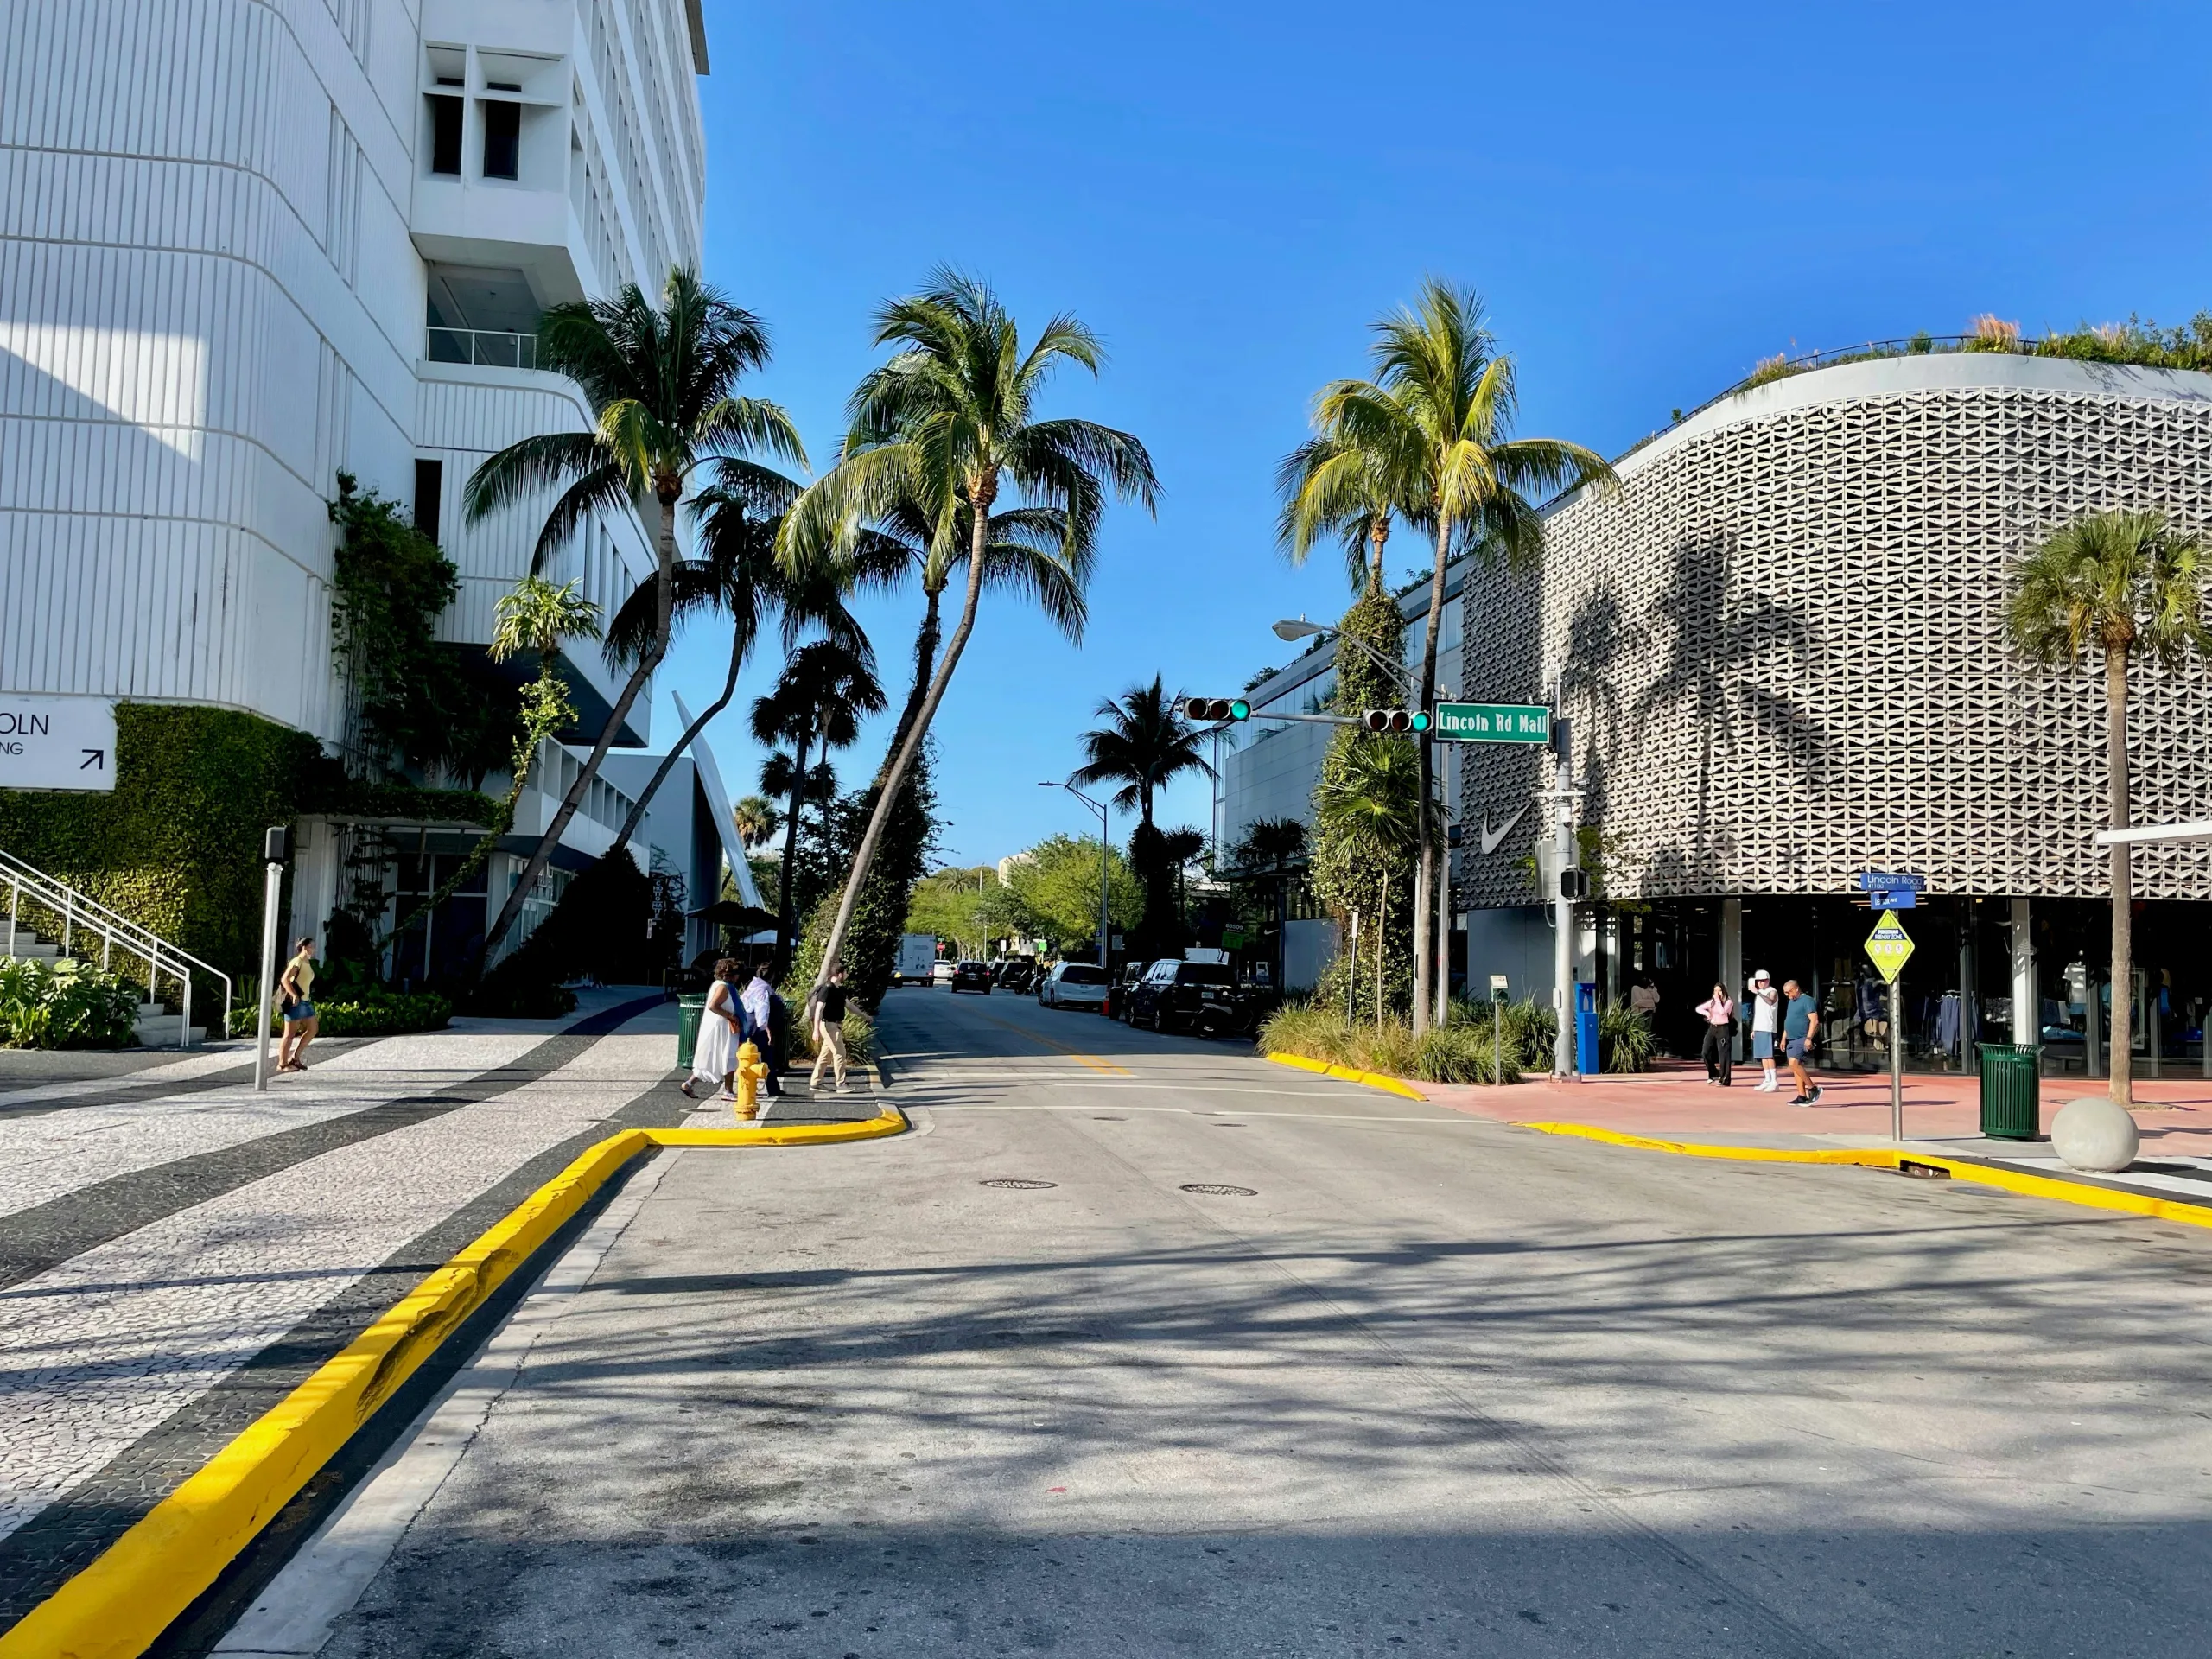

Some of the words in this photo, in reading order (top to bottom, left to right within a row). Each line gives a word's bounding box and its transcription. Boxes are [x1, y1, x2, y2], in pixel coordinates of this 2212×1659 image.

[1439, 712, 1489, 731] Lincoln
[1496, 713, 1512, 732] Rd
[1519, 715, 1546, 733] Mall
[1867, 875, 1898, 884] Lincoln
[1902, 876, 1923, 885] Road
